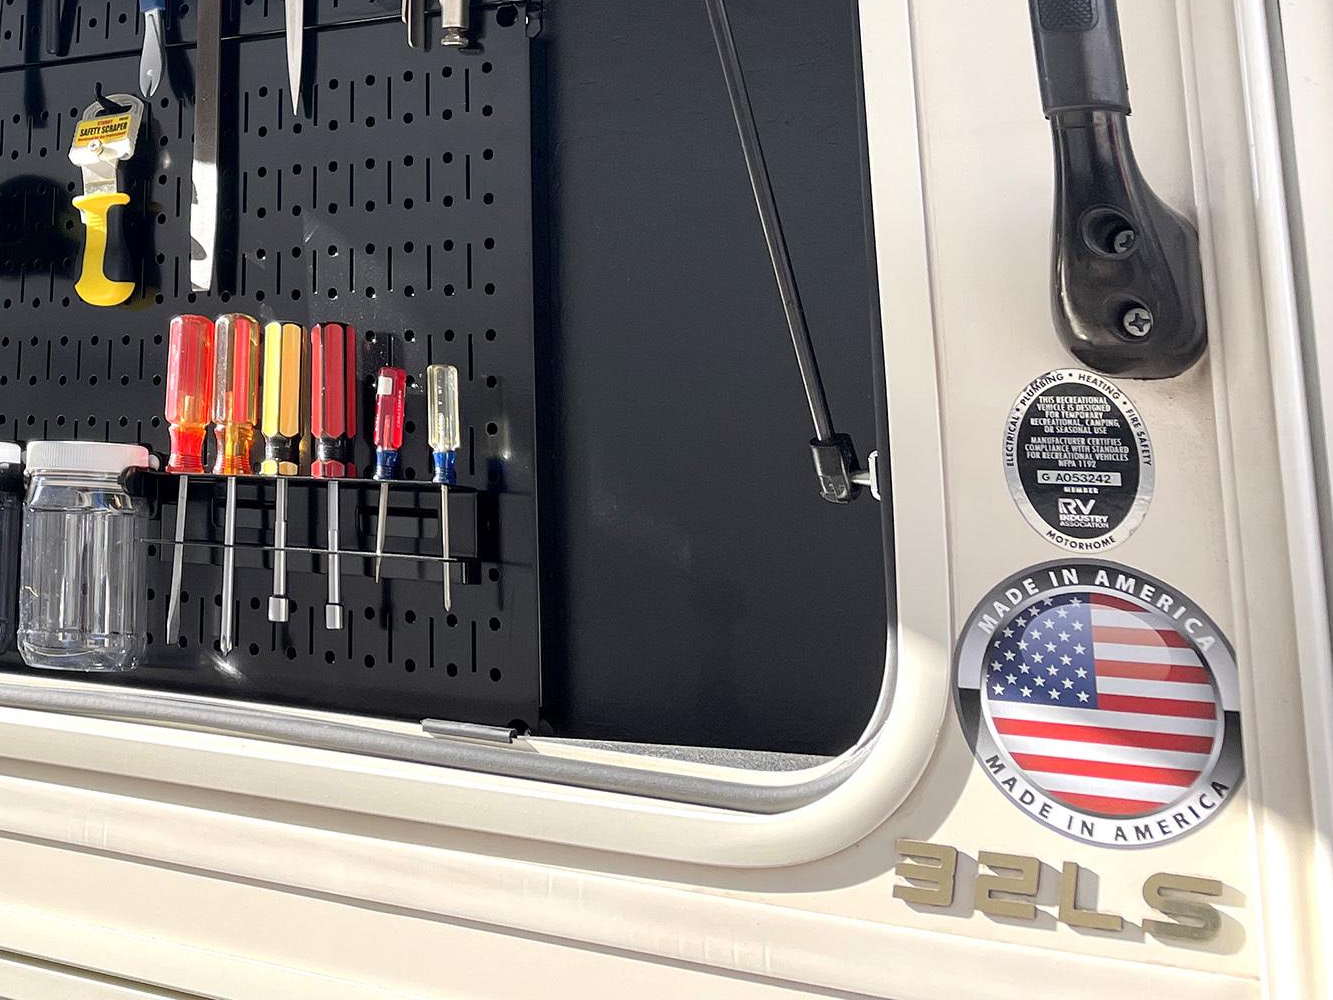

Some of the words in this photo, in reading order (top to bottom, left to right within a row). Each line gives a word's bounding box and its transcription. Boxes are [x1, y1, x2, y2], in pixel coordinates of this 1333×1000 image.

[79, 126, 101, 137] SAFETY
[101, 121, 128, 135] SCRAPER
[1020, 373, 1064, 406] PLUMBING
[1078, 373, 1121, 400] HEATING
[1039, 396, 1055, 404] THIS
[1056, 396, 1108, 405] RECREATIONAL
[1037, 403, 1066, 411] VEHICLE
[1068, 404, 1075, 412] IS
[1076, 404, 1111, 412] DESIGNED
[1045, 411, 1061, 419] FOR
[1085, 419, 1121, 428] CAMPING,
[1056, 426, 1092, 434] SEASONAL
[1006, 416, 1020, 467] ELECTRICAL
[1126, 408, 1142, 429] FIRE
[1136, 430, 1153, 466] SAFETY
[1031, 437, 1086, 445] MANUFACTURER
[1087, 438, 1122, 446] CERTIFIES
[1025, 444, 1070, 453] COMPLIANCE
[1072, 445, 1090, 453] WITH
[1092, 445, 1129, 454] STANDARD
[1042, 452, 1093, 460] RECREATIONAL
[1095, 453, 1129, 461] VEHICLES
[1058, 460, 1076, 468] NFPA
[1078, 460, 1096, 468] 1192
[1042, 473, 1050, 481] G
[1056, 473, 1112, 483] A053242
[1063, 486, 1099, 494] MEMBER
[1058, 498, 1096, 514] RV
[1059, 514, 1108, 523] INDUSTRY
[1059, 521, 1110, 529] ASSOCIATION
[1046, 530, 1116, 550] MOTORHOME
[977, 578, 1040, 635] MADE
[1048, 568, 1080, 587] IN
[1094, 569, 1217, 652] AMERICA
[985, 754, 1053, 819] MADE
[1066, 815, 1094, 837] IN
[1115, 780, 1230, 842] AMERICA
[892, 838, 1224, 942] 32LS
